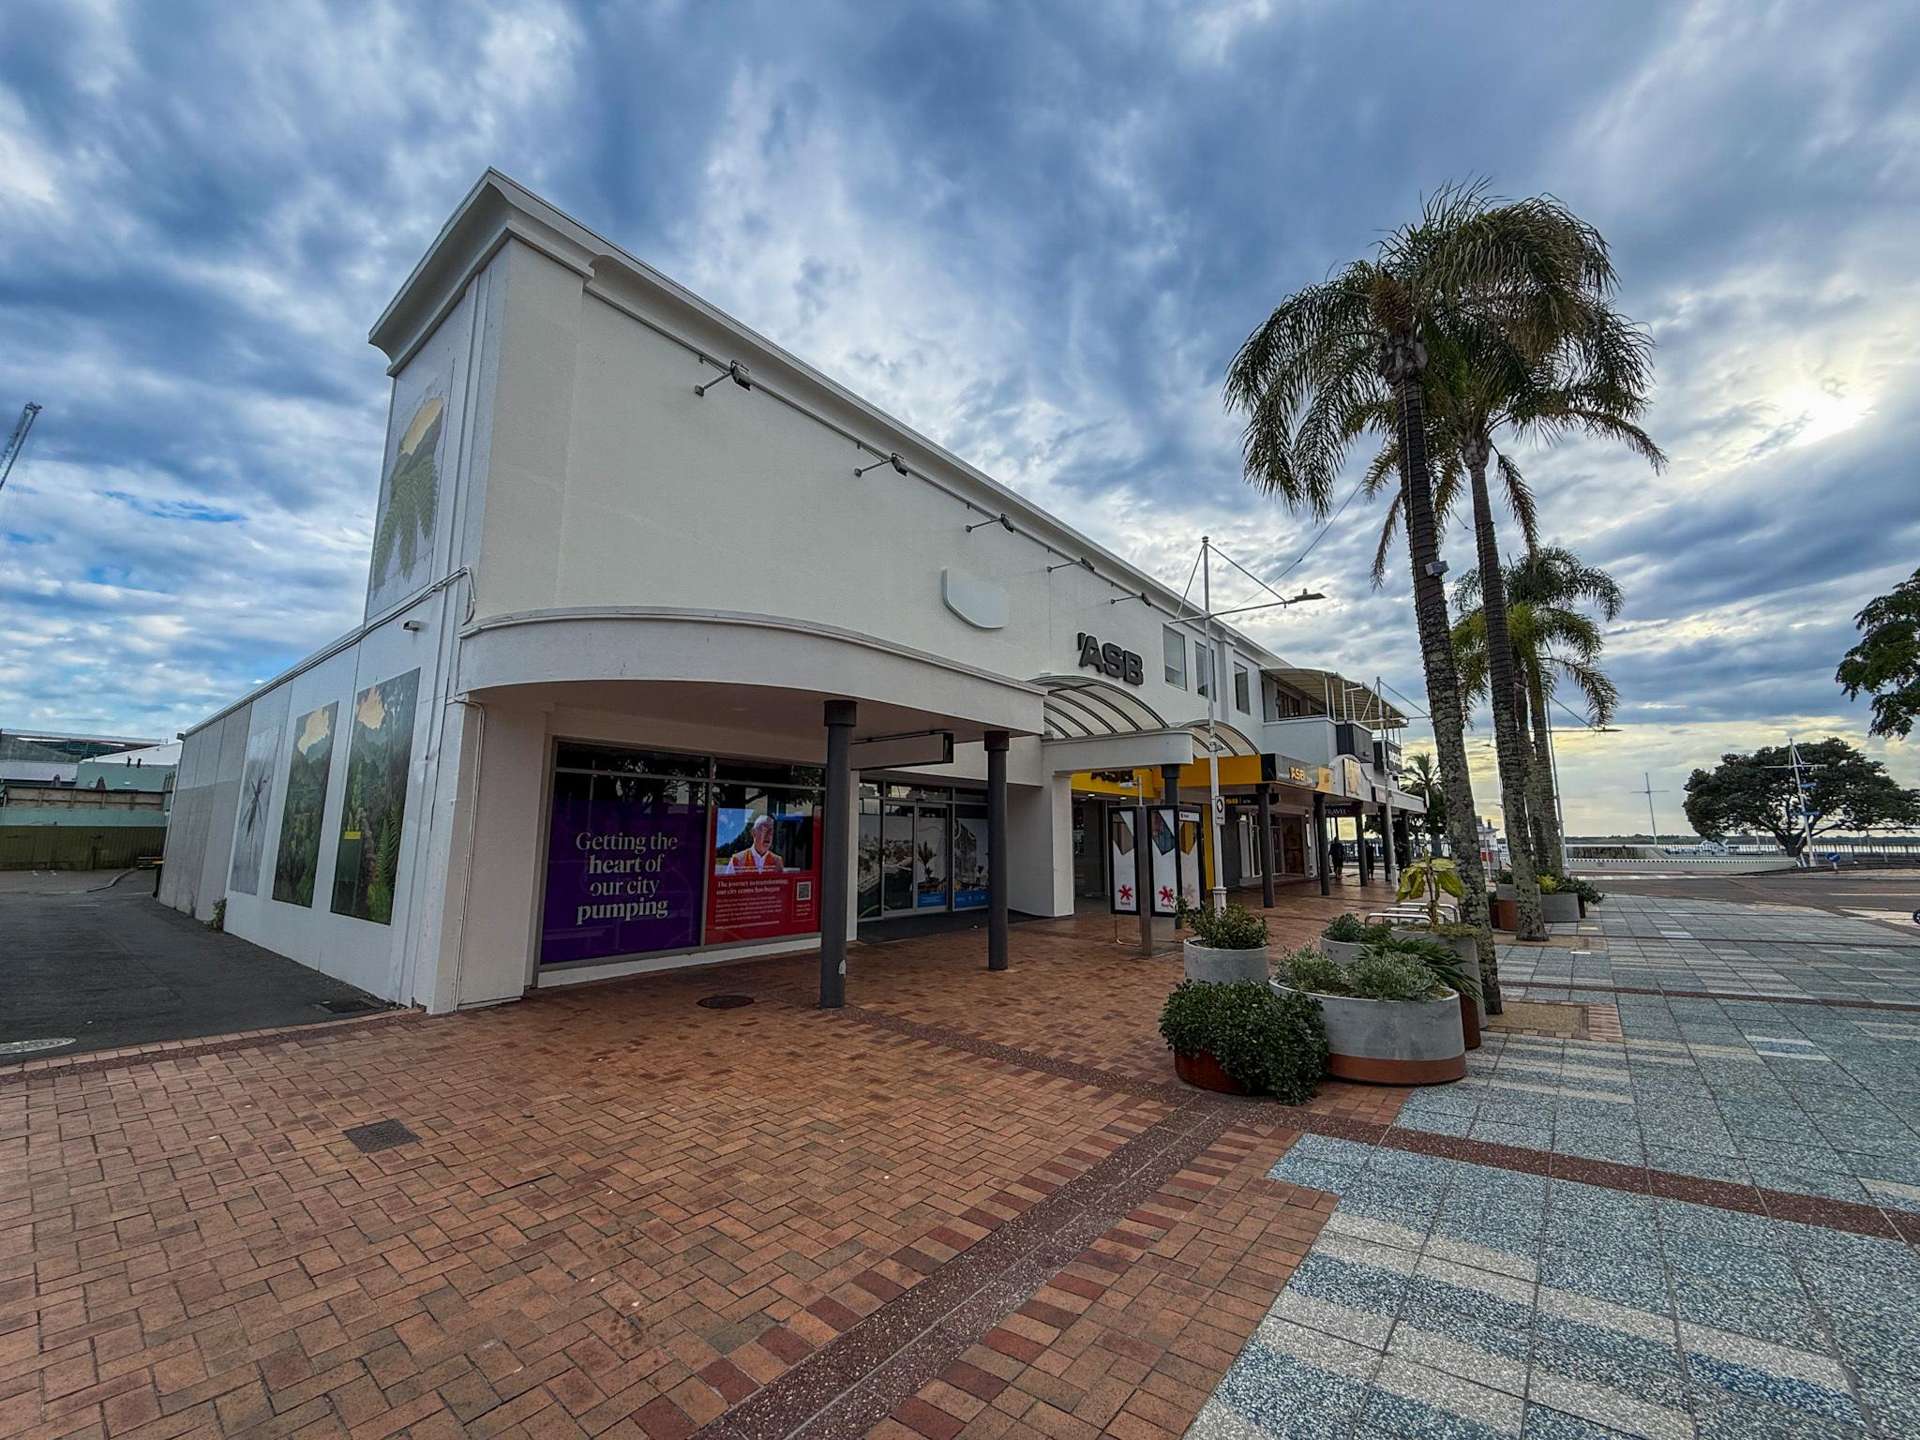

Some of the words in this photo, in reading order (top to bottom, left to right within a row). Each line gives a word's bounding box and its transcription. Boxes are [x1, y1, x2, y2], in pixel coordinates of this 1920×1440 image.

[1078, 632, 1143, 685] ASB
[575, 832, 646, 854] Getting
[650, 831, 679, 850] the
[588, 854, 642, 875] heart
[645, 853, 666, 873] of
[589, 879, 624, 897] our
[627, 876, 660, 898] city
[576, 896, 669, 925] pumping
